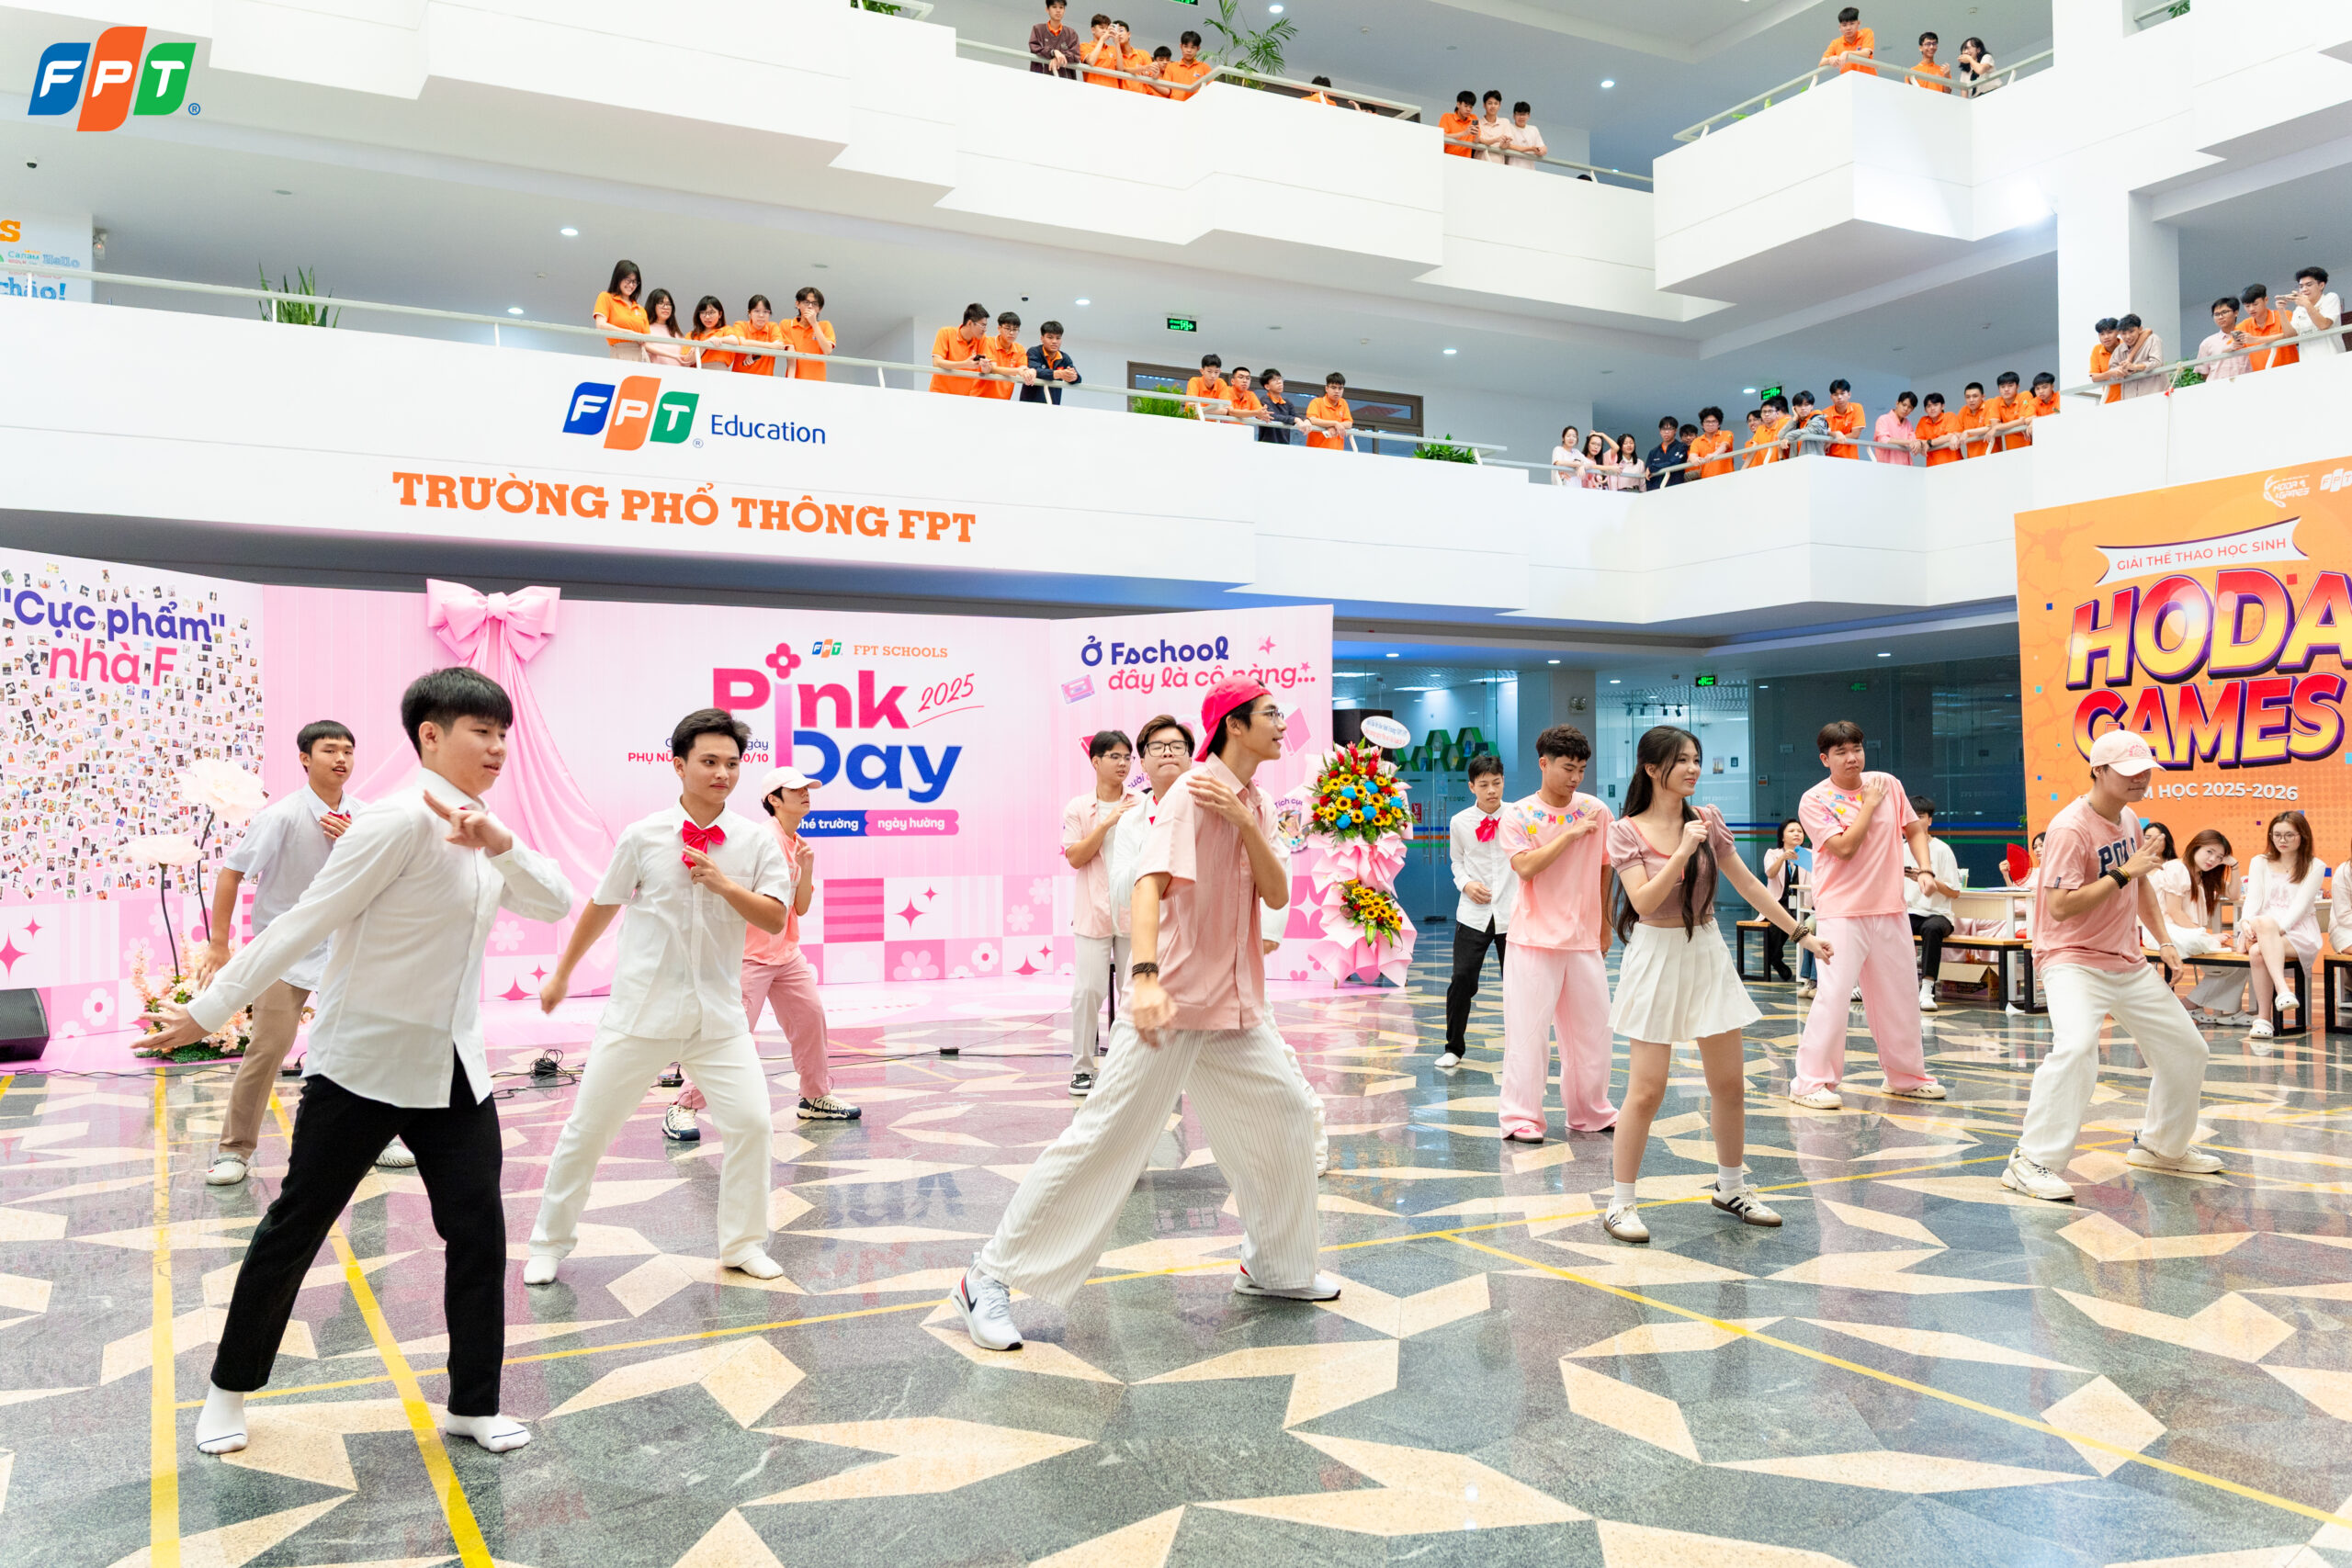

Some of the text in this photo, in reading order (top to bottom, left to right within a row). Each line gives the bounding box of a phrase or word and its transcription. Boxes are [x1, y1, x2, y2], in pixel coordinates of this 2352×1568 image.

[42, 254, 80, 268] Hello
[711, 413, 826, 446] Education
[392, 471, 976, 543] TRƯỜNG PHỔ THÔNG FPT
[2117, 537, 2287, 570] GIẢI THỂ THAO HỌC SINH
[2065, 567, 2352, 691] HODA
[49, 637, 177, 686] nhà F
[854, 645, 879, 656] FPT
[883, 646, 948, 658] SCHOOLS
[1081, 635, 1229, 667] Ở Fschool
[713, 642, 975, 735] Pink 2025
[1108, 669, 1155, 694] đây
[1160, 666, 1188, 688] là
[1194, 664, 1225, 686] cô
[2073, 671, 2347, 772] GAMES
[628, 751, 653, 765] PHỤ
[741, 751, 769, 763] 0/10
[746, 738, 769, 751] gày
[793, 730, 963, 803] Day
[2159, 783, 2198, 801] HỌC
[2202, 782, 2299, 802] 2025-2026
[818, 818, 859, 832] trường
[877, 818, 907, 831] ngày
[909, 817, 945, 831] hường
